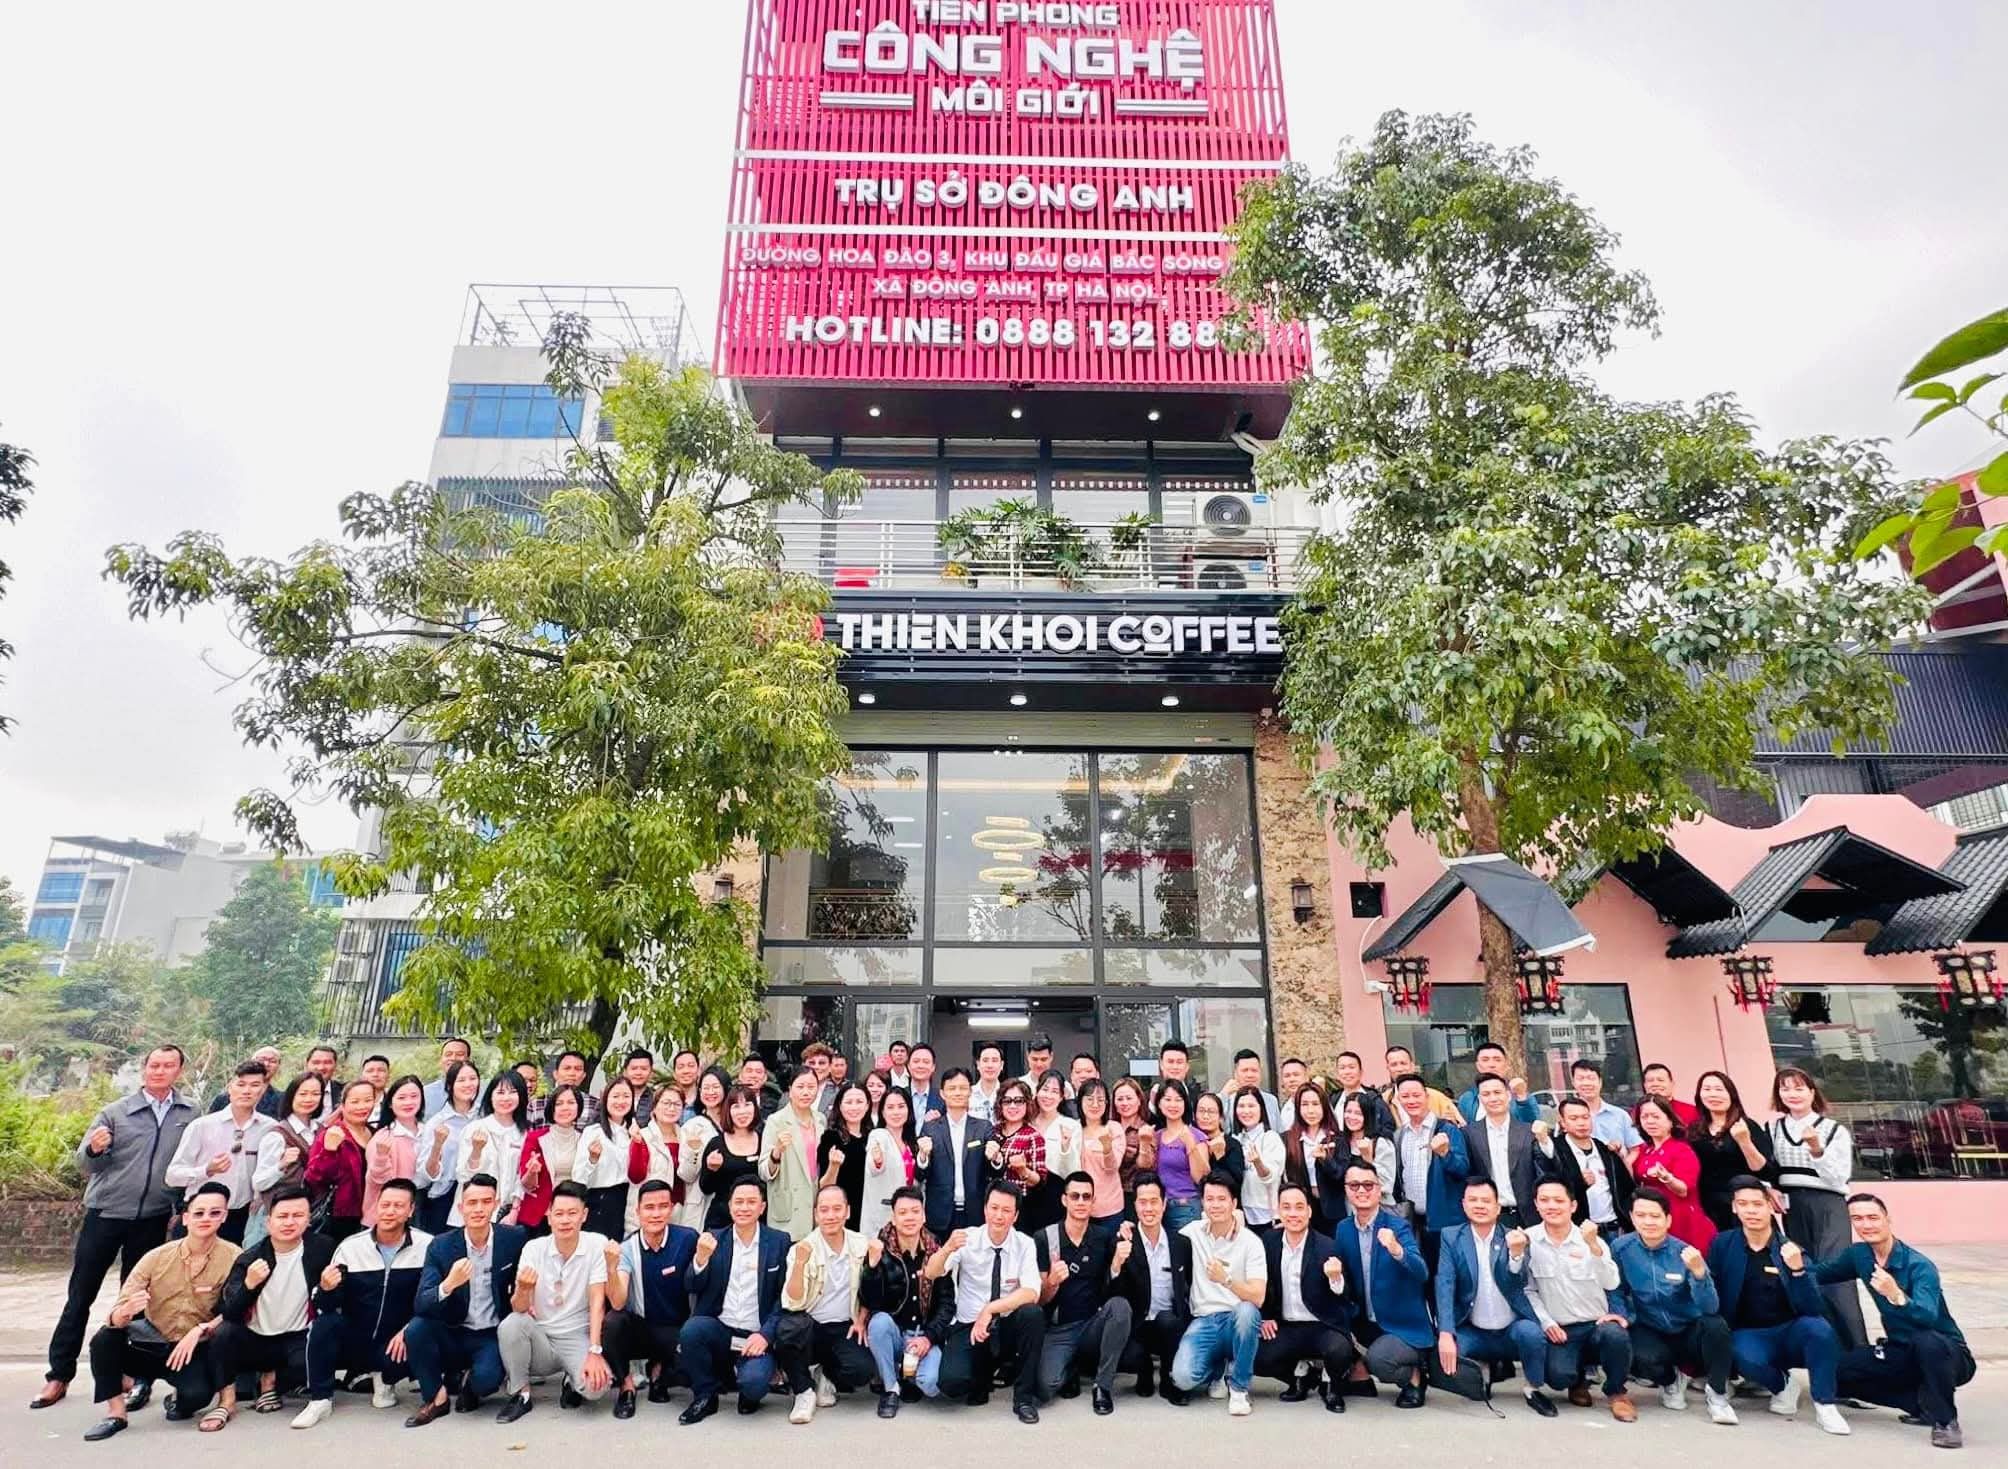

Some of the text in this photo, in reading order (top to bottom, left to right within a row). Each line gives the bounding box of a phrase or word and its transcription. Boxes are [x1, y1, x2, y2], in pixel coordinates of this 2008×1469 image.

[996, 2, 1119, 28] PHONG
[823, 20, 1205, 91] CÔNG NGHỆ
[931, 79, 1099, 118] MÔI GIỚI
[835, 169, 1194, 213] TRỤ SỞ ĐÔNG ANH
[828, 248, 876, 268] HOA
[964, 250, 1008, 271] KHU
[1014, 246, 1058, 272] ĐẤU
[1063, 249, 1104, 273] GIÁ
[1111, 248, 1155, 273] BẮC
[1162, 250, 1223, 275] SÔNG
[872, 275, 905, 298] XÃ
[912, 275, 977, 299] ĐÔNG
[1075, 279, 1109, 302] HÀ
[785, 315, 1241, 350] HOTLINE: 0888 132 88
[979, 614, 1098, 654] KHOI
[1108, 615, 1283, 656] COFFEE
